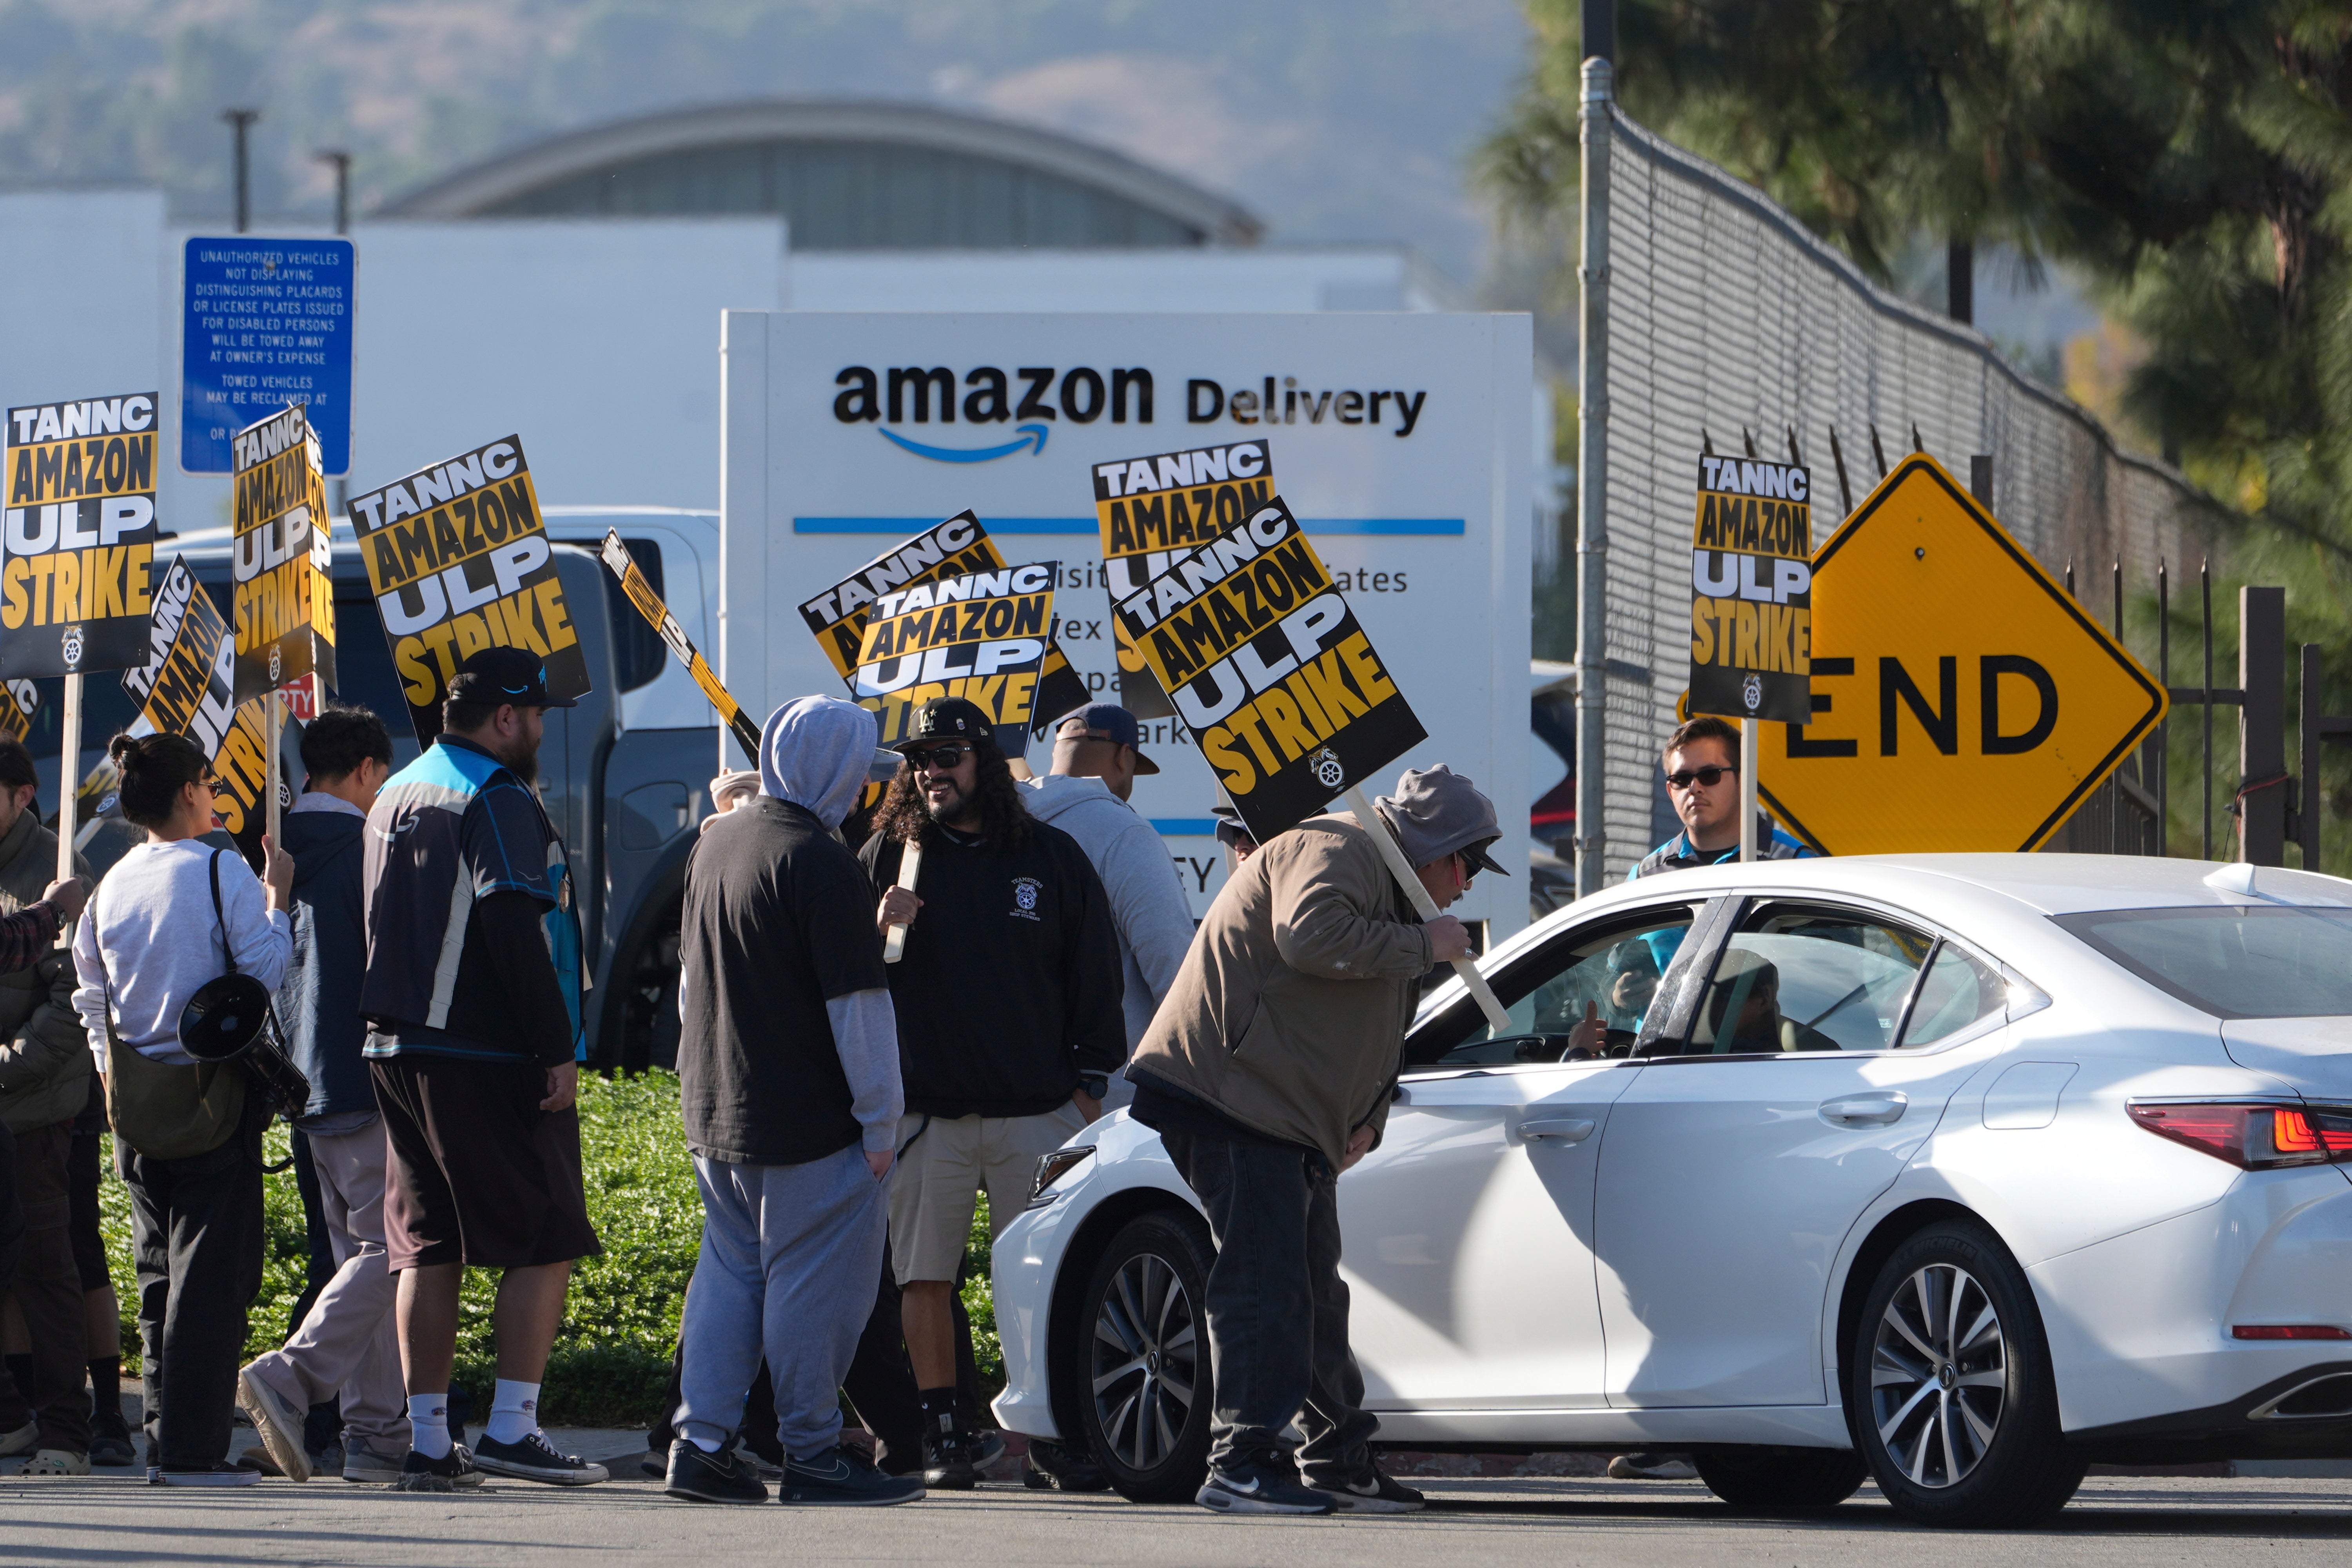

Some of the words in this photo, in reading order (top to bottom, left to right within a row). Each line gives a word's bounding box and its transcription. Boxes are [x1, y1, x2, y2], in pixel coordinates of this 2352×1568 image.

[201, 250, 283, 264] UNAUTHORIZED
[288, 252, 339, 265] VEHICLES
[225, 268, 246, 279] NOT
[251, 269, 313, 281] DISPLAYING
[194, 300, 209, 312] OR
[213, 301, 258, 313] LICENSE
[263, 302, 301, 314] PLATES
[305, 303, 344, 315] ISSUED
[196, 283, 282, 298] DISTINGUISHING
[287, 285, 342, 299] PLACARDS
[202, 317, 223, 329] FOR
[228, 318, 280, 330] DISABLED
[285, 319, 335, 332] PERSONS
[212, 334, 236, 346] WILL
[241, 335, 254, 346] BE
[260, 335, 294, 347] TOWED
[298, 336, 325, 347] AWAY
[210, 351, 222, 362] AT
[226, 352, 273, 364] OWNER'S
[278, 352, 326, 365] EXPENSE
[222, 374, 257, 387] TOWED
[261, 375, 313, 388] VEHICLES
[13, 396, 152, 443] TANNC
[207, 392, 228, 403] MAY
[233, 392, 247, 404] BE
[251, 392, 312, 405] RECLAIMED
[315, 393, 327, 405] AT
[833, 366, 1154, 423] amazon
[1187, 377, 1426, 437] Delivery
[211, 427, 225, 440] OR
[235, 408, 303, 472] TANNC
[12, 434, 151, 505] AMAZON
[237, 451, 307, 534] AMAZON
[354, 443, 517, 530] TANNC
[1098, 444, 1264, 497] TANNC
[1703, 458, 1807, 501] TANNC
[5, 495, 154, 556] ULP
[235, 506, 309, 582] ULP
[372, 476, 537, 590] AMAZON
[1110, 481, 1269, 554] AMAZON
[1699, 495, 1807, 556] AMAZON
[1, 543, 152, 630] STRIKE
[378, 535, 549, 636] ULP
[810, 519, 975, 624] TANNC
[877, 565, 1049, 620] TANNC
[1059, 561, 1109, 588] isit
[1122, 508, 1288, 628] TANNC
[1693, 550, 1811, 604] ULP
[126, 565, 191, 699] TANNC
[235, 556, 310, 657] STRIKE
[866, 595, 1045, 662] AMAZON
[1150, 537, 1325, 687] AMAZON
[1691, 596, 1811, 675] STRIKE
[150, 588, 221, 735] AMAZON
[855, 639, 1043, 697] ULP
[1171, 593, 1346, 728] ULP
[919, 709, 935, 733] LA
[1203, 630, 1397, 795] STRIKE
[1786, 654, 2059, 758] END
[1011, 877, 1044, 889] TEAMSTERS
